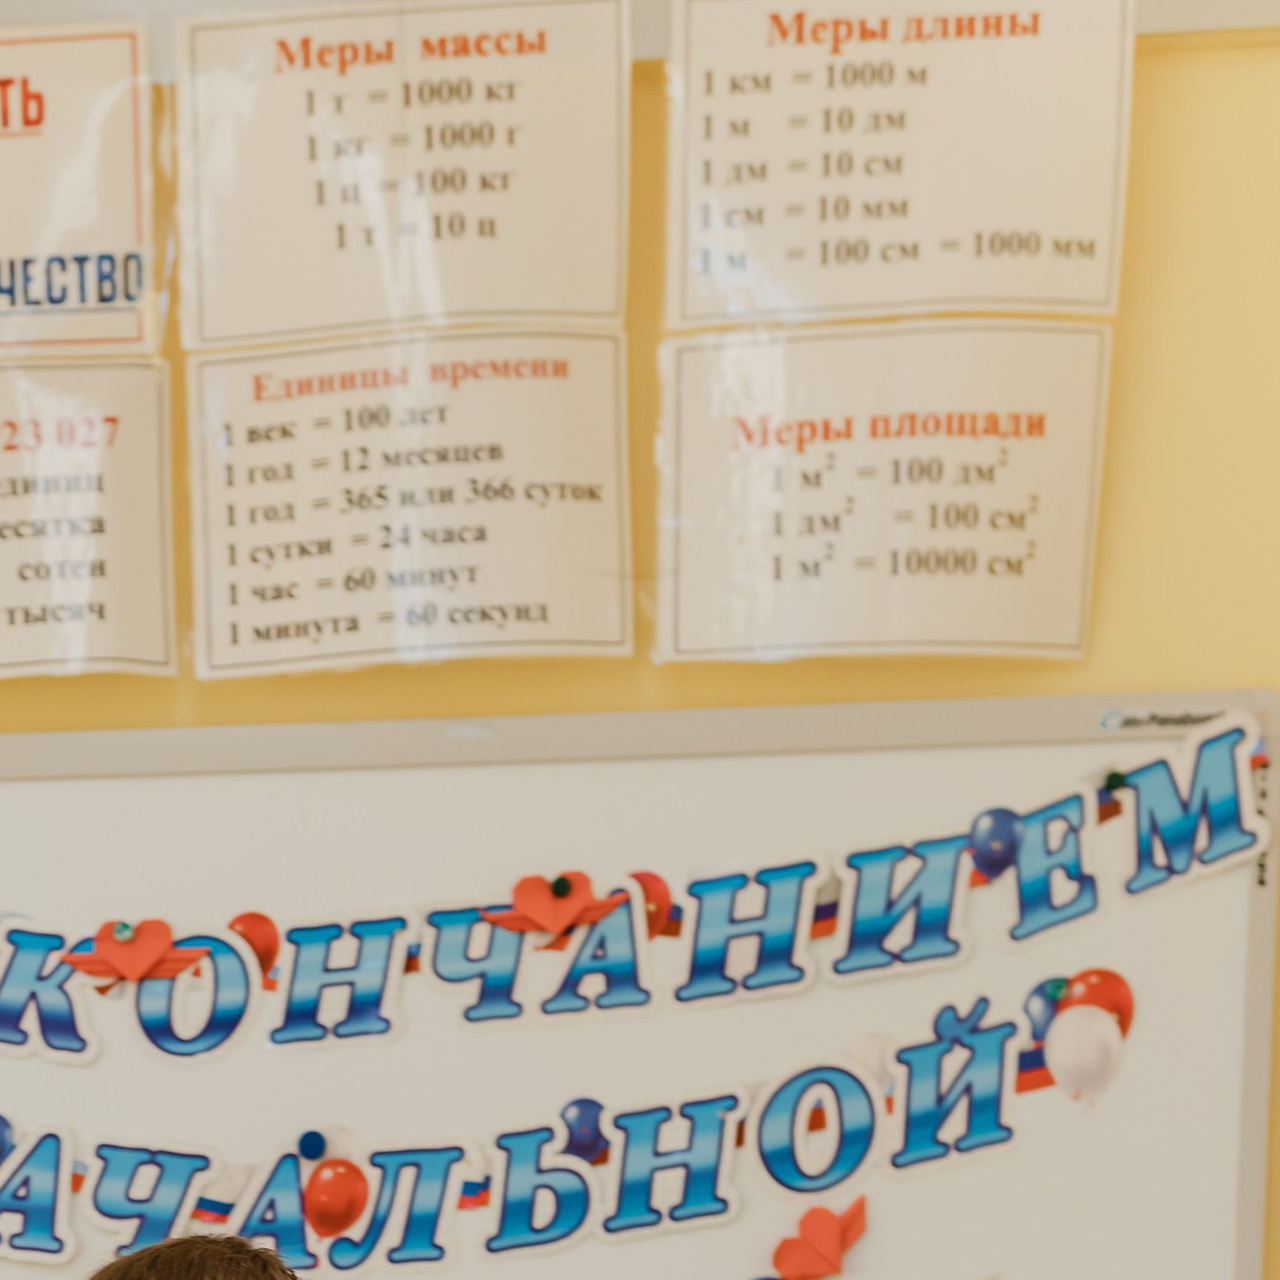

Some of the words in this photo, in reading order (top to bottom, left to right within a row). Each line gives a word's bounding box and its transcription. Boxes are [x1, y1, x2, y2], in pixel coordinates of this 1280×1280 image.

[767, 12, 889, 55] Меры
[902, 12, 1041, 44] длины
[275, 36, 394, 76] Меры
[421, 29, 546, 61] массы
[305, 90, 315, 115] 1
[401, 77, 472, 109] 1000
[485, 80, 520, 102] кг
[702, 71, 714, 96] 1
[729, 71, 772, 95] км
[824, 62, 894, 92] 1000
[907, 66, 928, 87] м
[702, 115, 713, 140] 1
[728, 118, 750, 139] м
[822, 107, 855, 135] 10
[863, 109, 907, 134] дм
[307, 136, 317, 162] 1
[333, 138, 367, 160] кг
[424, 123, 494, 152] 1000
[479, 171, 513, 193] кг
[701, 160, 712, 186] 1
[724, 161, 768, 186] дм
[822, 152, 854, 179] 10
[865, 153, 903, 176] см
[433, 213, 466, 240] 10
[725, 206, 764, 230] см
[818, 195, 850, 224] 10
[862, 198, 909, 220] мм
[818, 239, 869, 267] 100
[880, 241, 920, 263] см
[973, 232, 1041, 260] 1000
[1052, 237, 1096, 259] мм
[252, 363, 409, 402] Единицы
[430, 357, 569, 390] времени
[56, 415, 120, 450] 027
[246, 421, 295, 445] век
[342, 405, 390, 433] 100
[732, 413, 854, 453] Меры
[869, 411, 1047, 443] площади
[224, 464, 235, 488] 1
[247, 461, 296, 485] год
[340, 447, 370, 474] 12
[382, 442, 504, 468] месяцев
[890, 458, 944, 486] 100
[226, 503, 236, 528] 1
[249, 502, 296, 526] год
[339, 484, 388, 515] 365
[399, 484, 455, 508] или
[464, 475, 515, 503] 366
[524, 480, 604, 508] суток
[773, 511, 783, 537] 1
[926, 503, 979, 530] 100
[227, 542, 238, 567] 1
[250, 536, 334, 569] сутки
[378, 524, 410, 551] 24
[420, 522, 488, 545] часа
[17, 558, 107, 582] сотен
[773, 556, 784, 581] 1
[889, 549, 976, 577] 10000
[229, 582, 239, 607] 1
[251, 581, 300, 605] час
[344, 567, 376, 593] 60
[387, 563, 482, 589] минут
[4, 601, 107, 629] тысяч
[230, 621, 240, 645] 1
[251, 614, 361, 645] минута
[405, 599, 438, 627] 60
[447, 603, 550, 632] секунд
